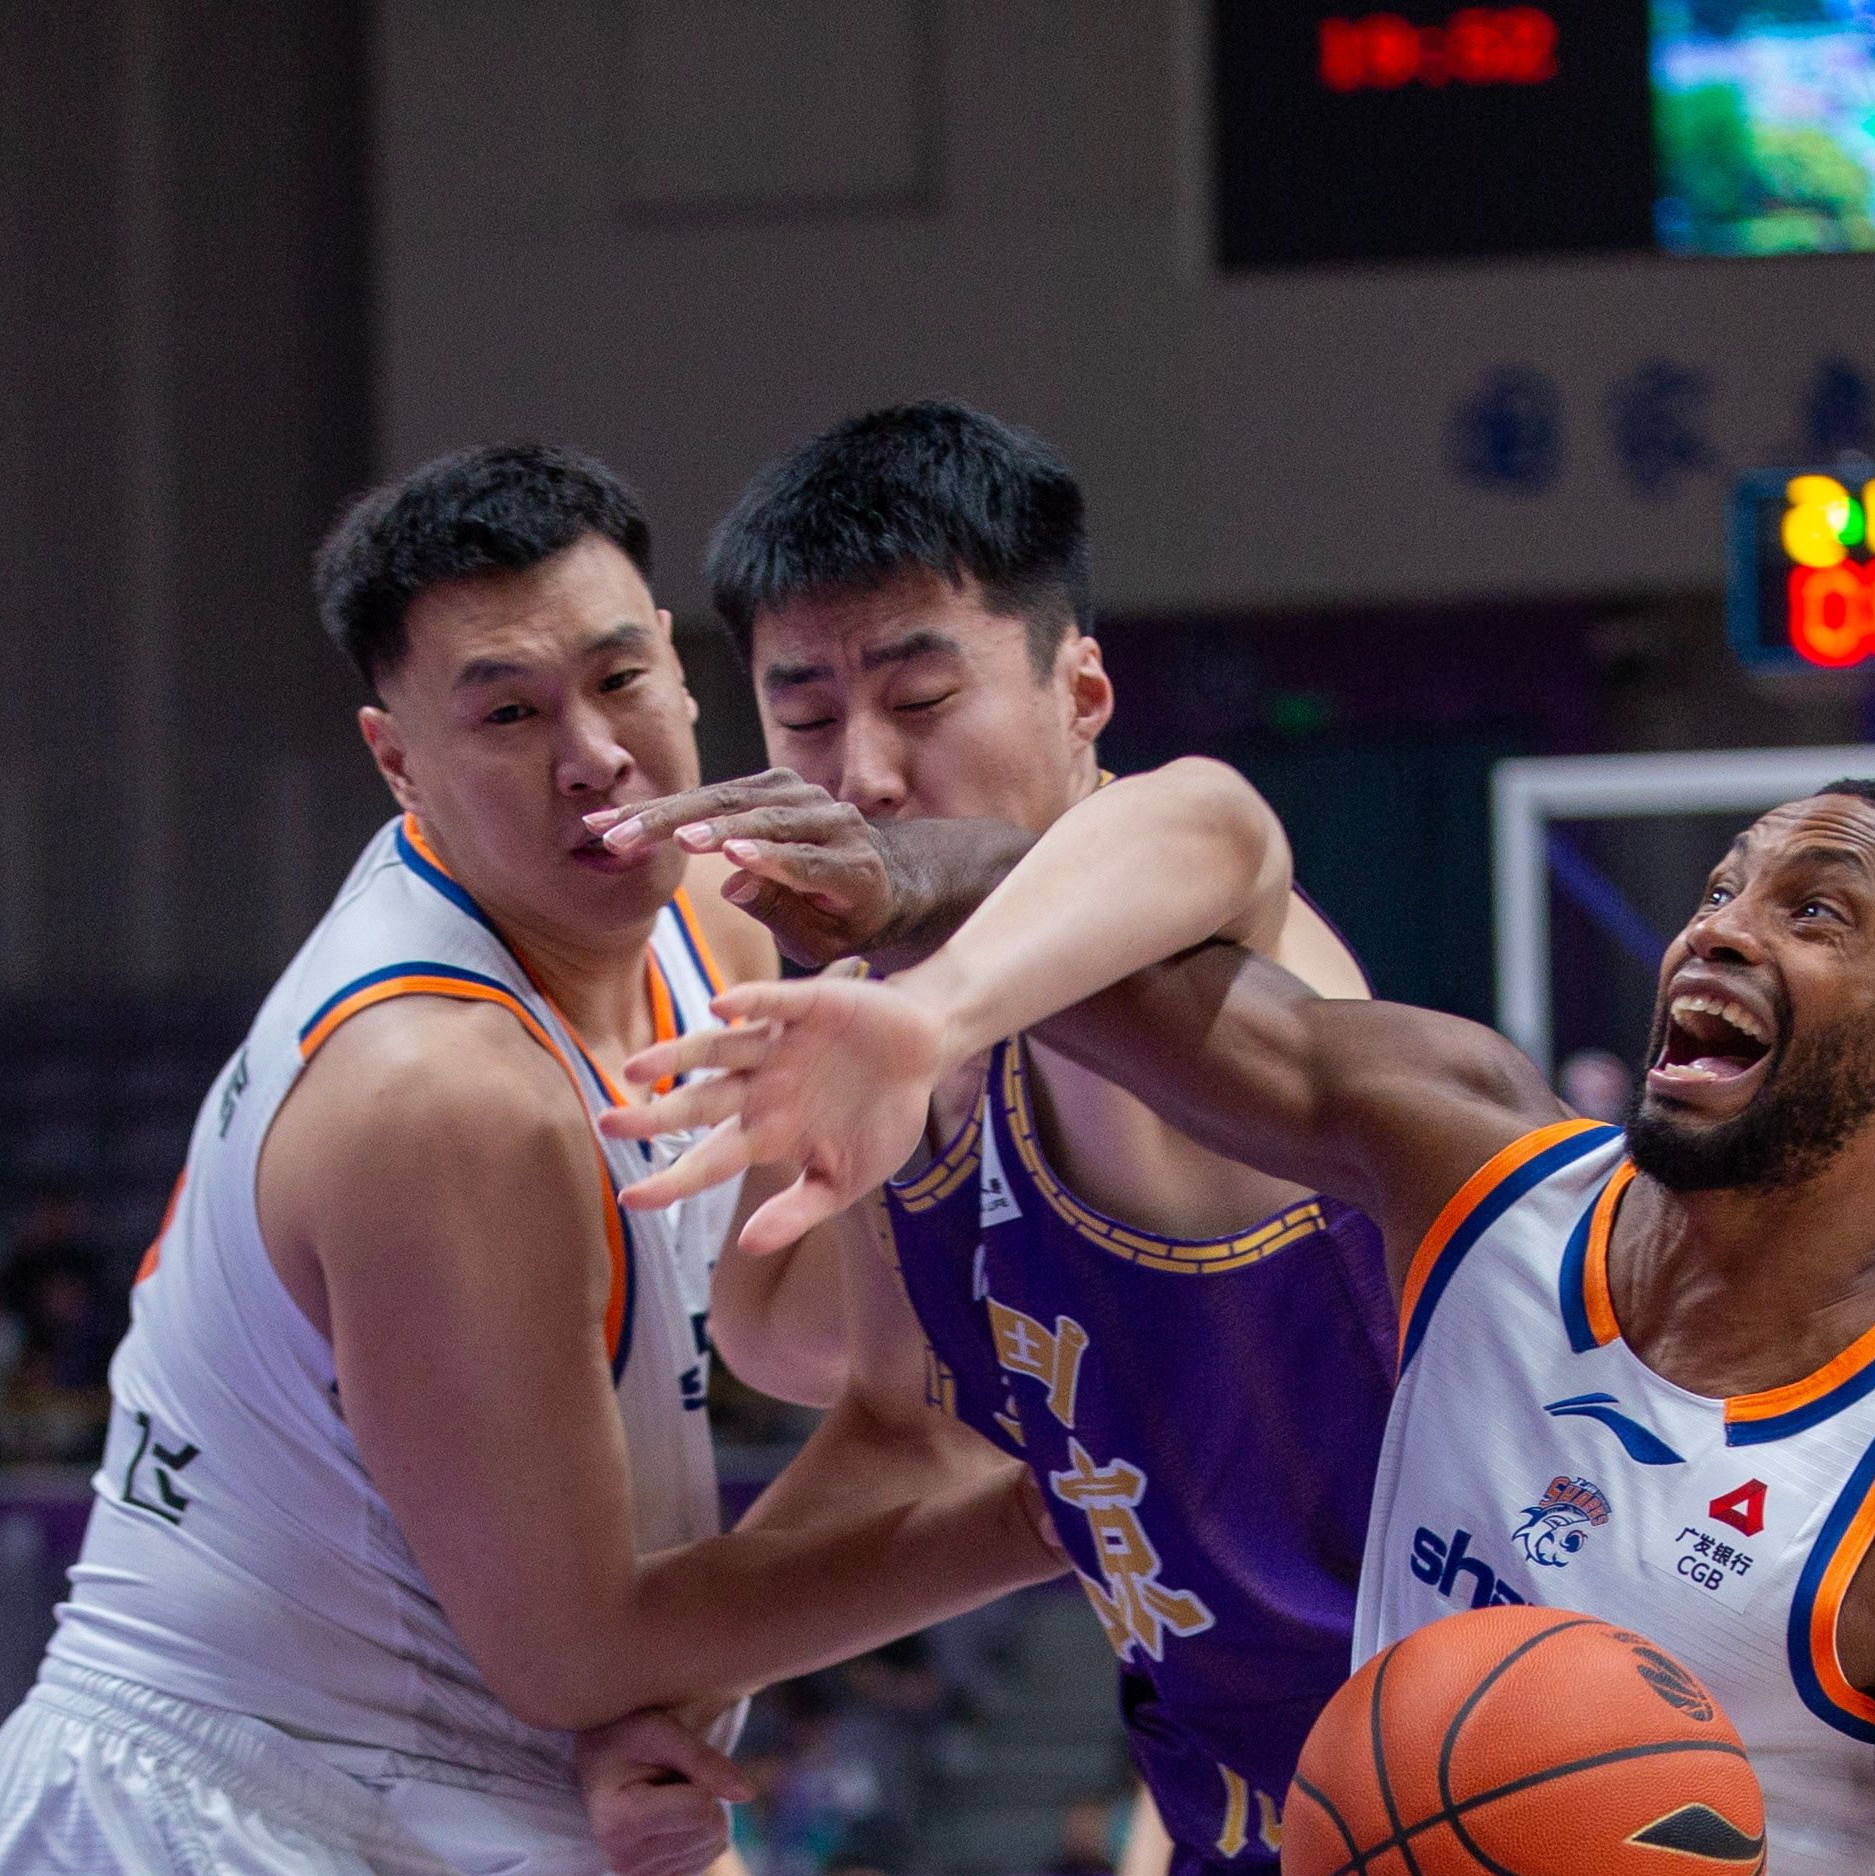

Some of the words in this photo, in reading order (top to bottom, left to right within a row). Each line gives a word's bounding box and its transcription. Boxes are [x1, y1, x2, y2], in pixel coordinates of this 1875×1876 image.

[1675, 1527, 1753, 1576] 广发银行
[1677, 1556, 1724, 1590] CGB
